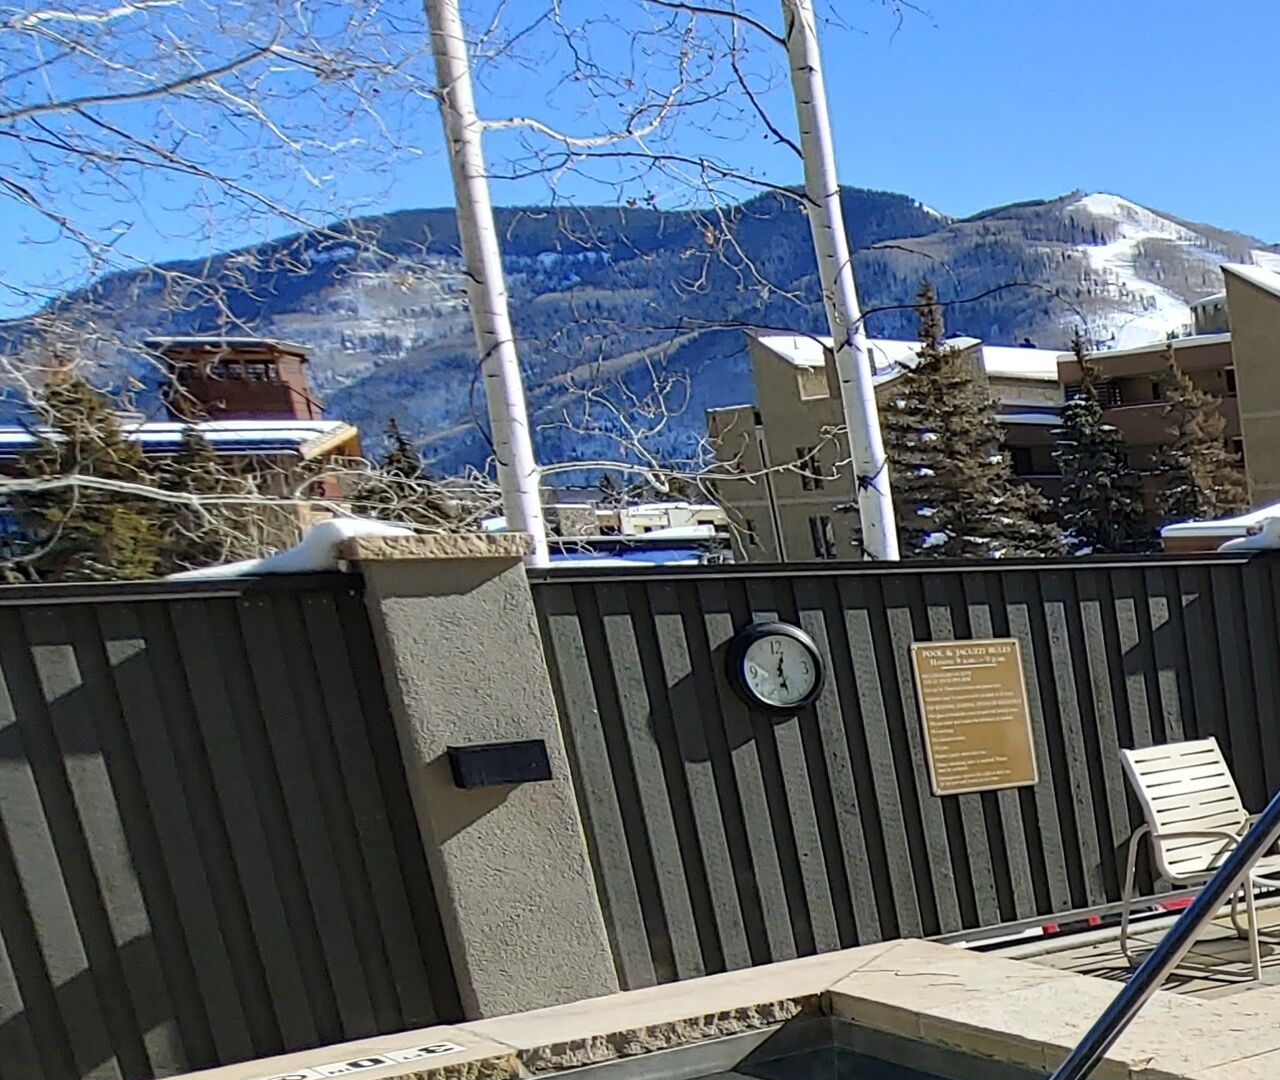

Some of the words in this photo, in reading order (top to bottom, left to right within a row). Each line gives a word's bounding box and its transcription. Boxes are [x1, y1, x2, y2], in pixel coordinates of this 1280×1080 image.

[770, 640, 782, 656] 12
[922, 649, 944, 658] POOL
[946, 649, 953, 657] &
[956, 647, 986, 657] JACUZZI
[988, 646, 1011, 654] RULES
[749, 665, 758, 680] 9
[800, 660, 809, 675] 3
[417, 1044, 455, 1054] 3
[345, 1058, 387, 1069] 0
